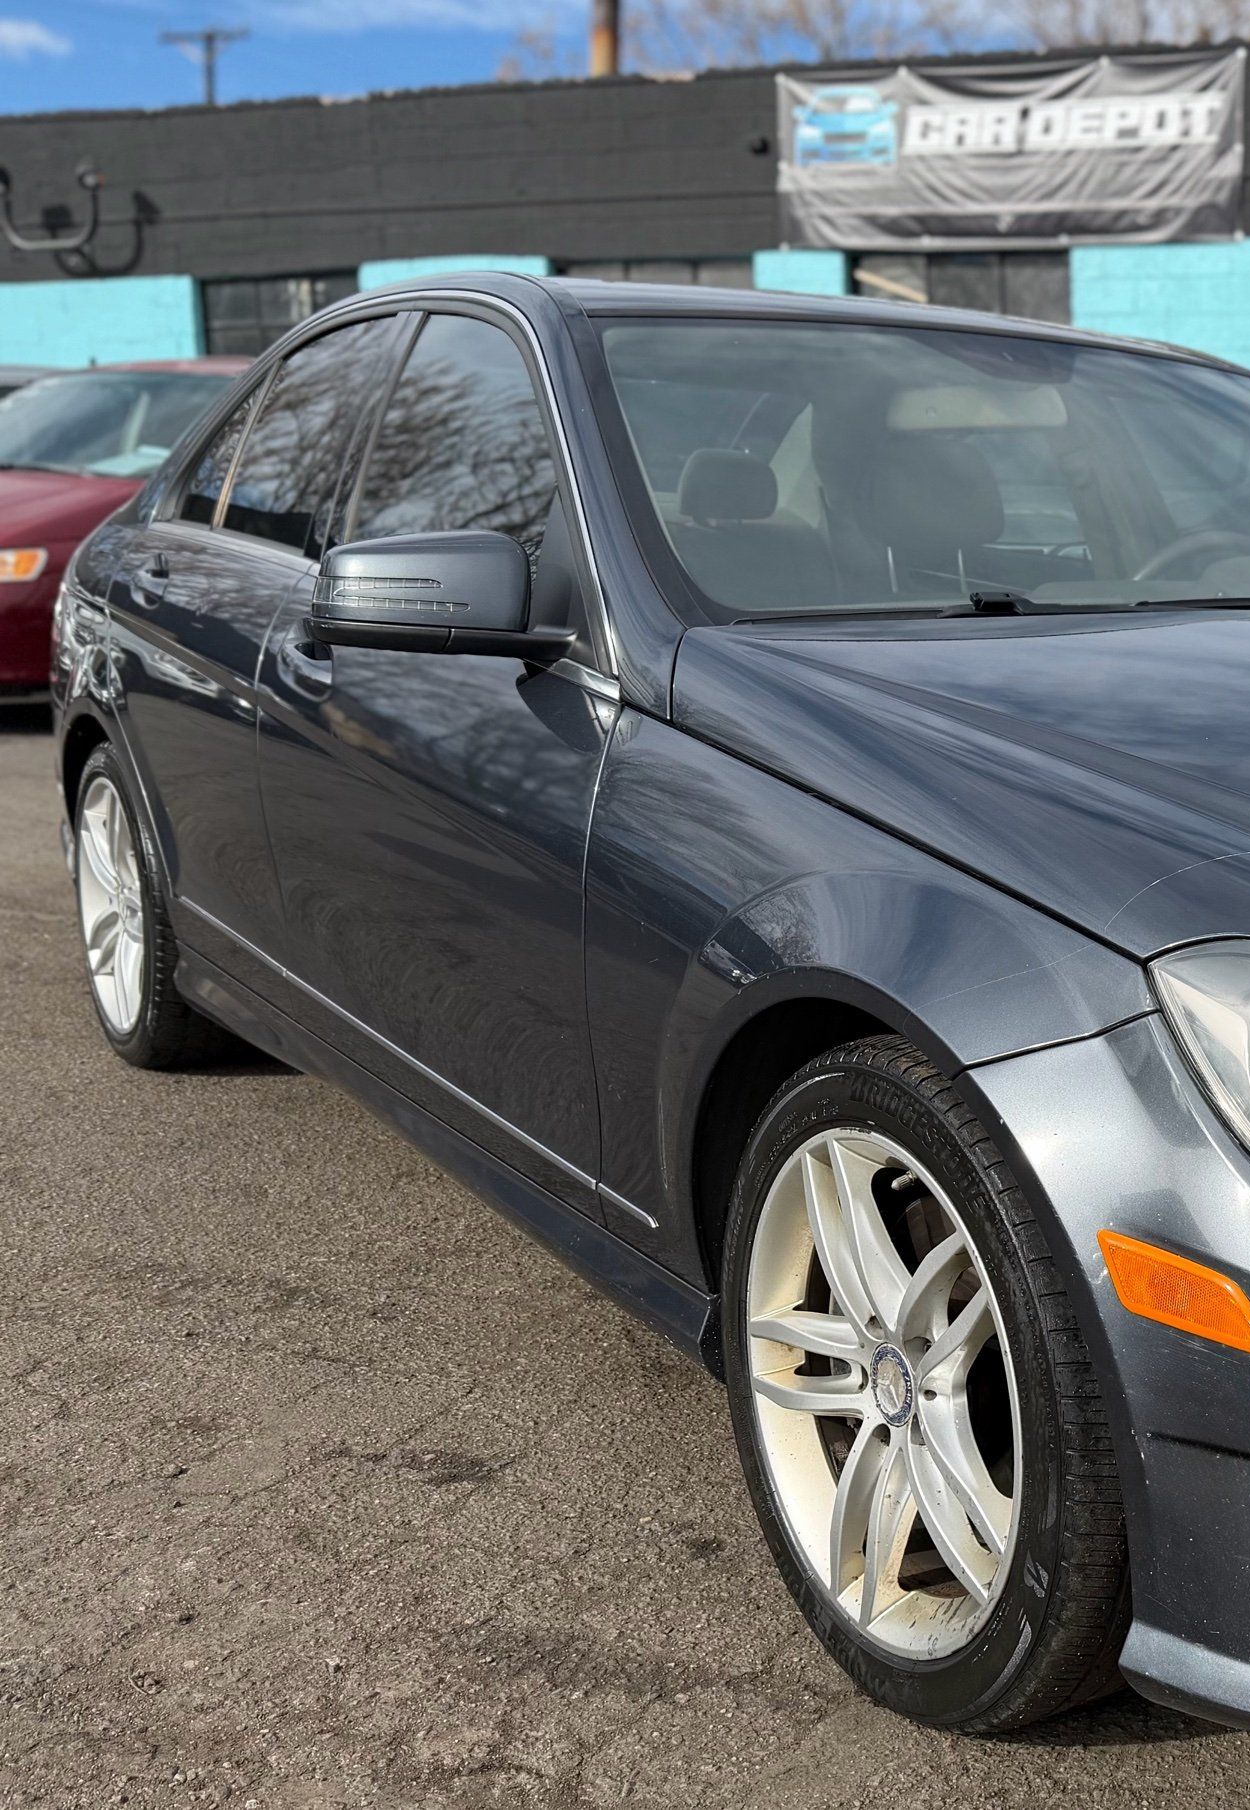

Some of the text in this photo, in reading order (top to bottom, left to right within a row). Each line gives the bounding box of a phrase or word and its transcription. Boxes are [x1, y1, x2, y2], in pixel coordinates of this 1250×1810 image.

[902, 90, 1224, 154] CAR DEPOT
[848, 1070, 991, 1213] BRIDGESTONE
